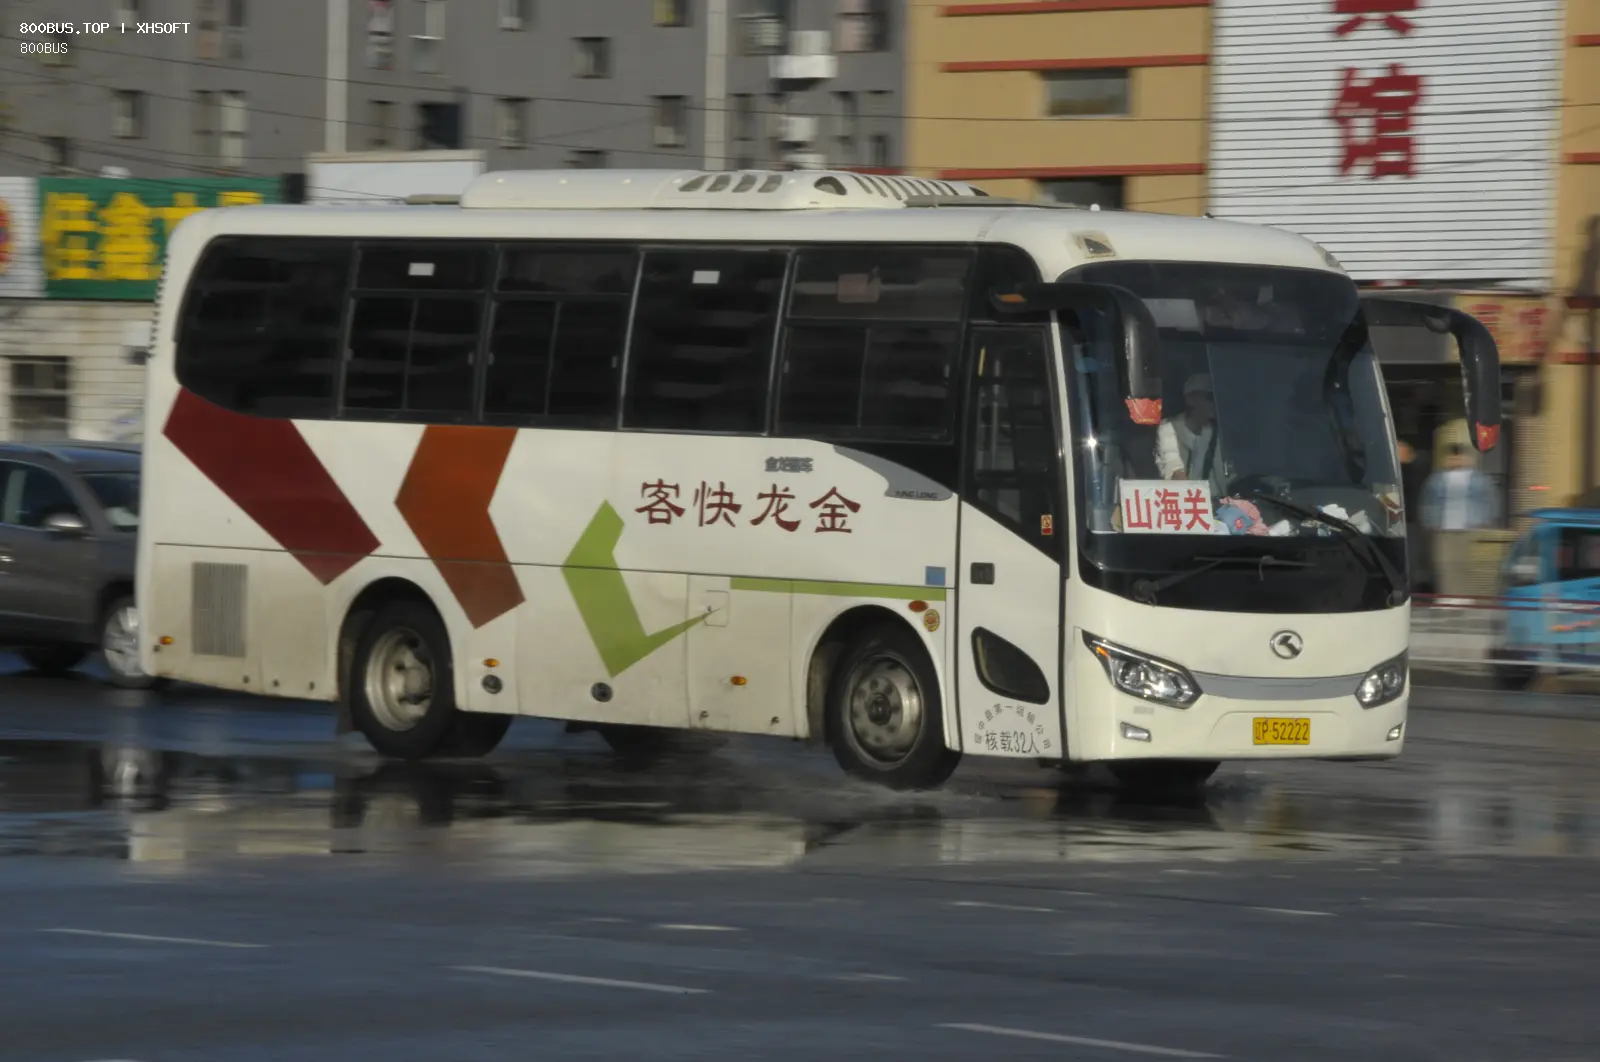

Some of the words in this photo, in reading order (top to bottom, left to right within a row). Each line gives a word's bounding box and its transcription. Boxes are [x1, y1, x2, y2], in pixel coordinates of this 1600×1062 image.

[1125, 488, 1211, 531] 山海关
[985, 730, 1040, 754] 核载32人
